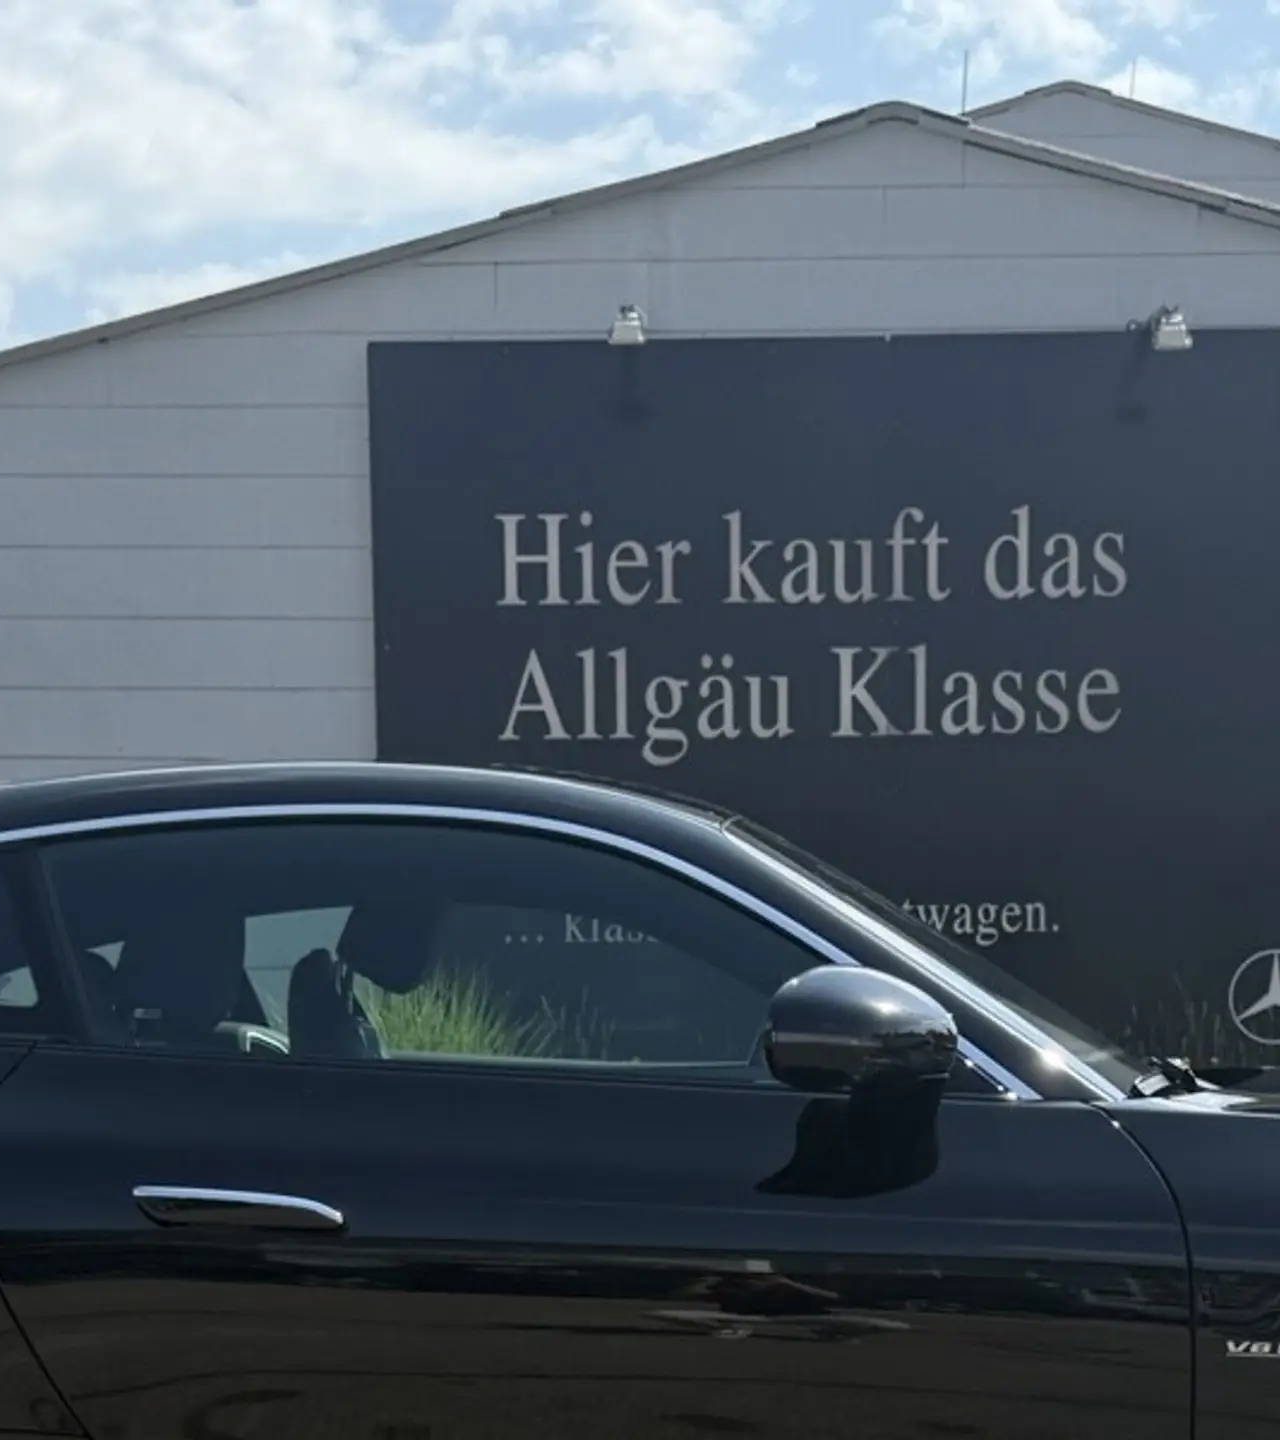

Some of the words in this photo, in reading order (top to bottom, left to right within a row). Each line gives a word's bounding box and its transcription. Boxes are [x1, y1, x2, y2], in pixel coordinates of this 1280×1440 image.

[495, 511, 691, 606] Hier
[722, 507, 950, 604] kauft
[983, 504, 1127, 600] das
[497, 647, 794, 766] Allgäu
[830, 644, 1122, 737] Klasse
[1226, 1340, 1272, 1353] V8
